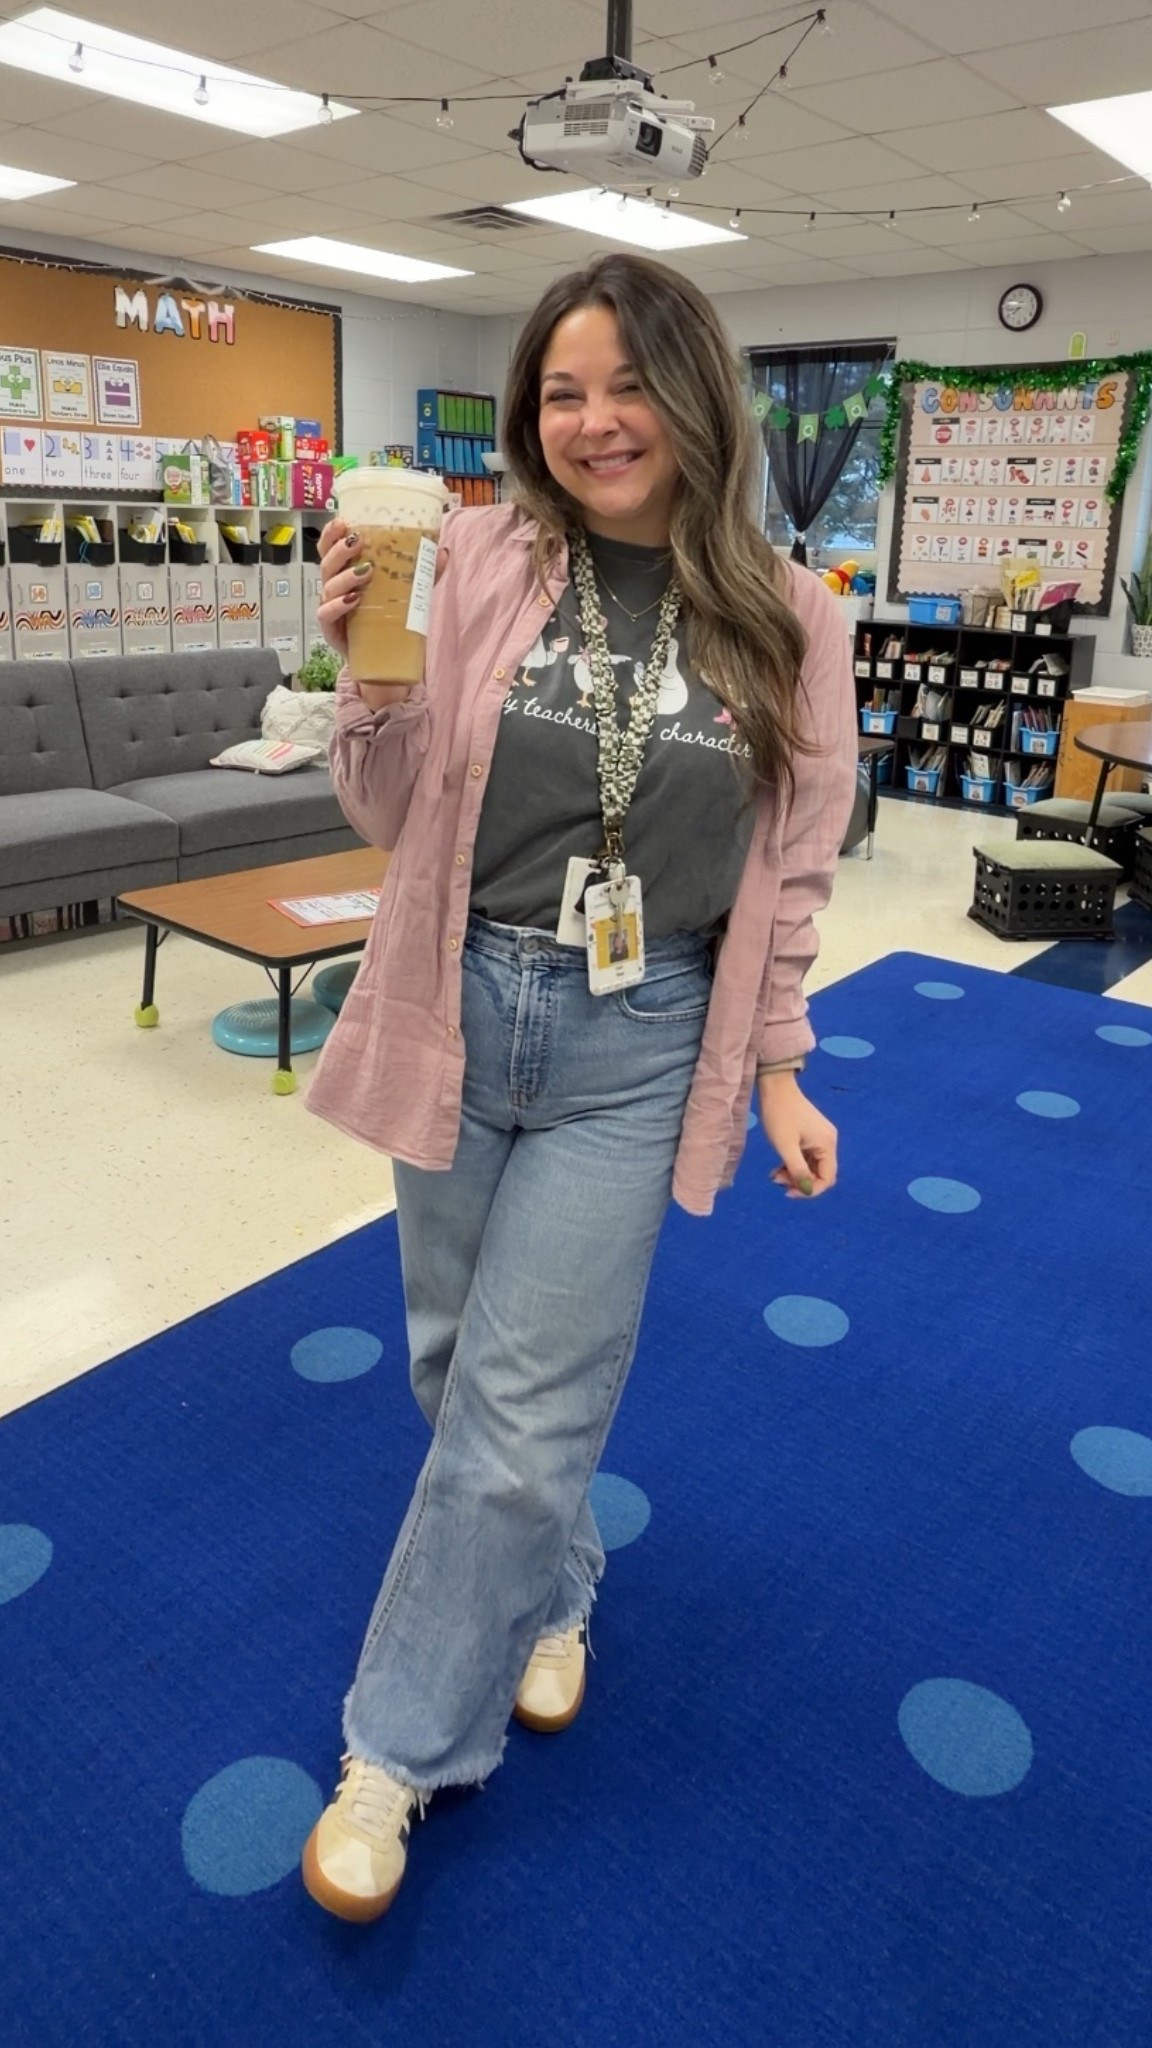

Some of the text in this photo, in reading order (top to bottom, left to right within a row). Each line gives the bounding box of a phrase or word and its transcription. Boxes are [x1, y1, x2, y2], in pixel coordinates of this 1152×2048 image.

[114, 285, 236, 346] MATH
[14, 353, 32, 364] Plus
[45, 435, 56, 457] 2
[84, 437, 92, 459] 3
[120, 440, 134, 461] 4
[155, 442, 164, 464] 5
[5, 467, 25, 475] one
[46, 465, 65, 477] two
[84, 468, 111, 480] three
[120, 470, 140, 481] four
[523, 696, 598, 735] teachers
[660, 721, 752, 758] character
